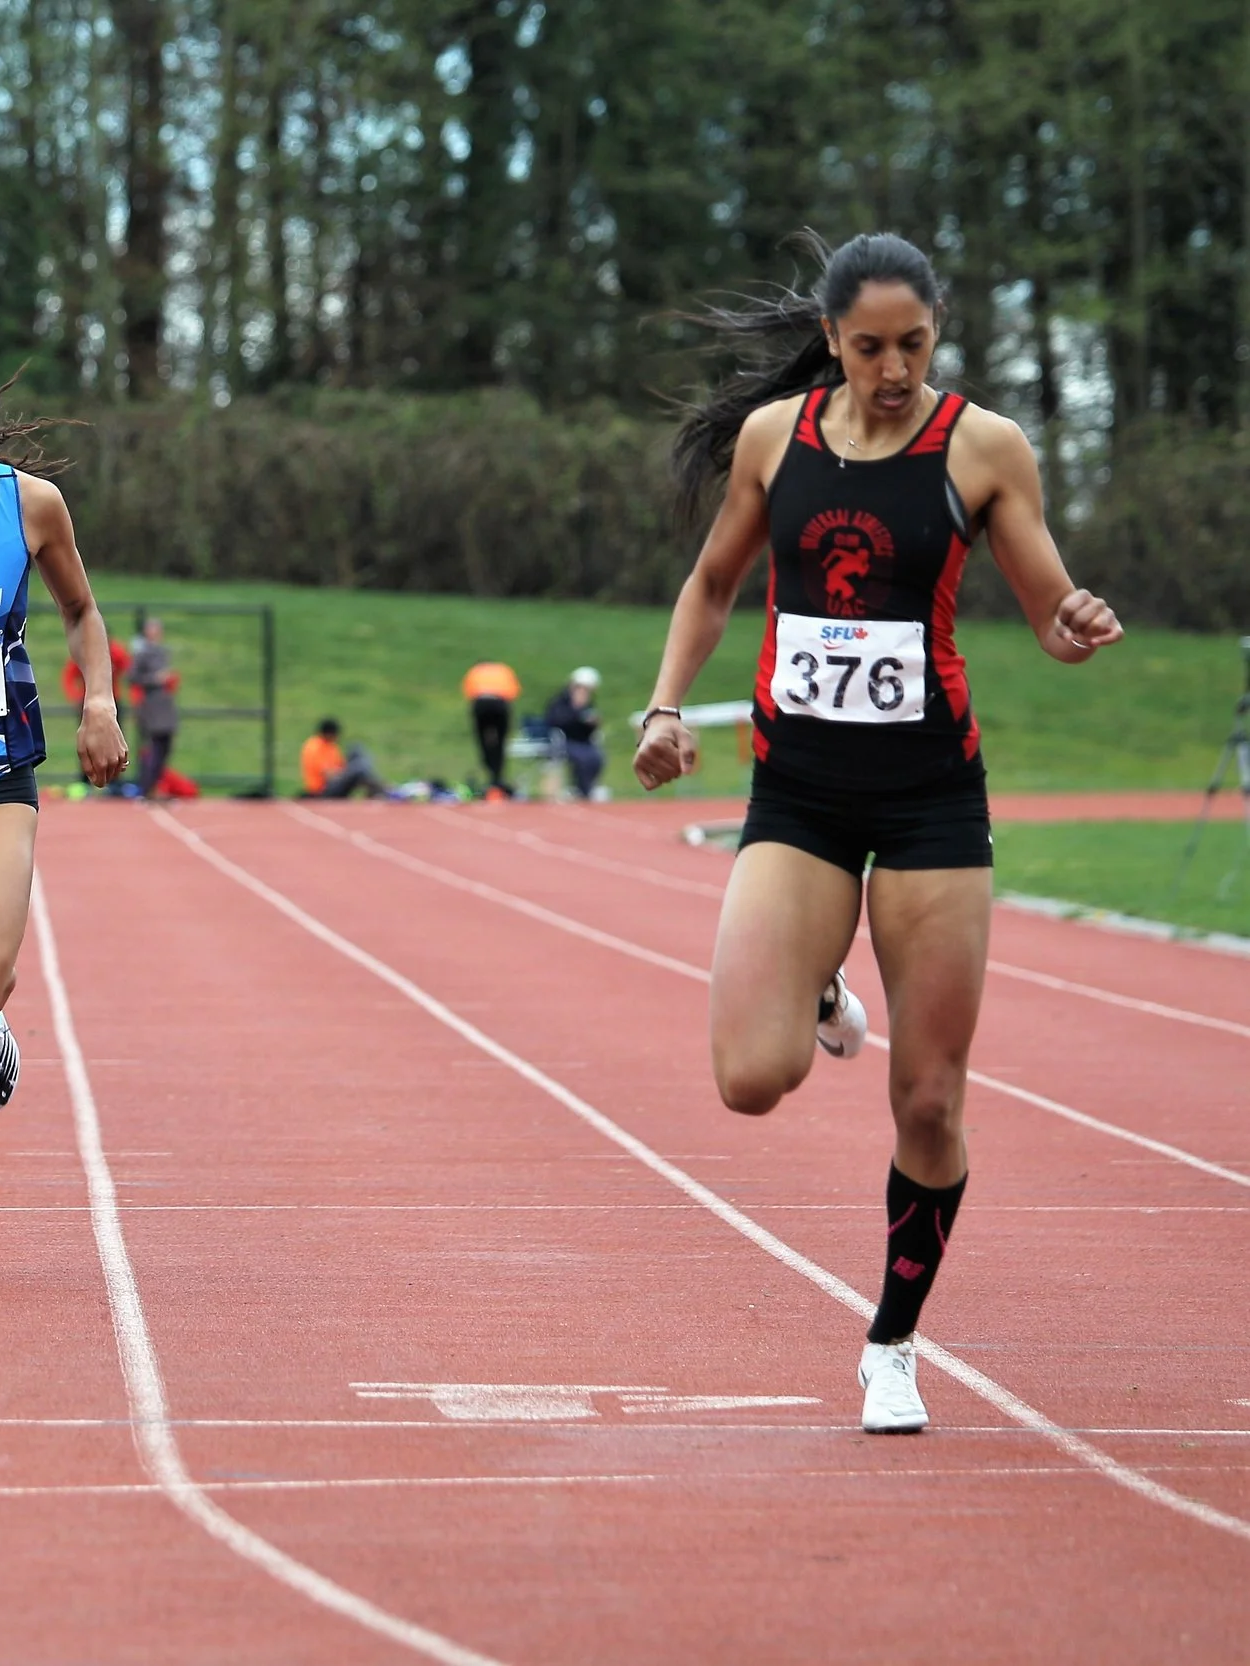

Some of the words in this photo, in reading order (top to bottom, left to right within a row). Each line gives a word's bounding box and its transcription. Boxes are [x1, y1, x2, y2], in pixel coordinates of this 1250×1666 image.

[827, 597, 866, 617] UAC
[820, 625, 856, 641] SFU
[786, 650, 905, 711] 376
